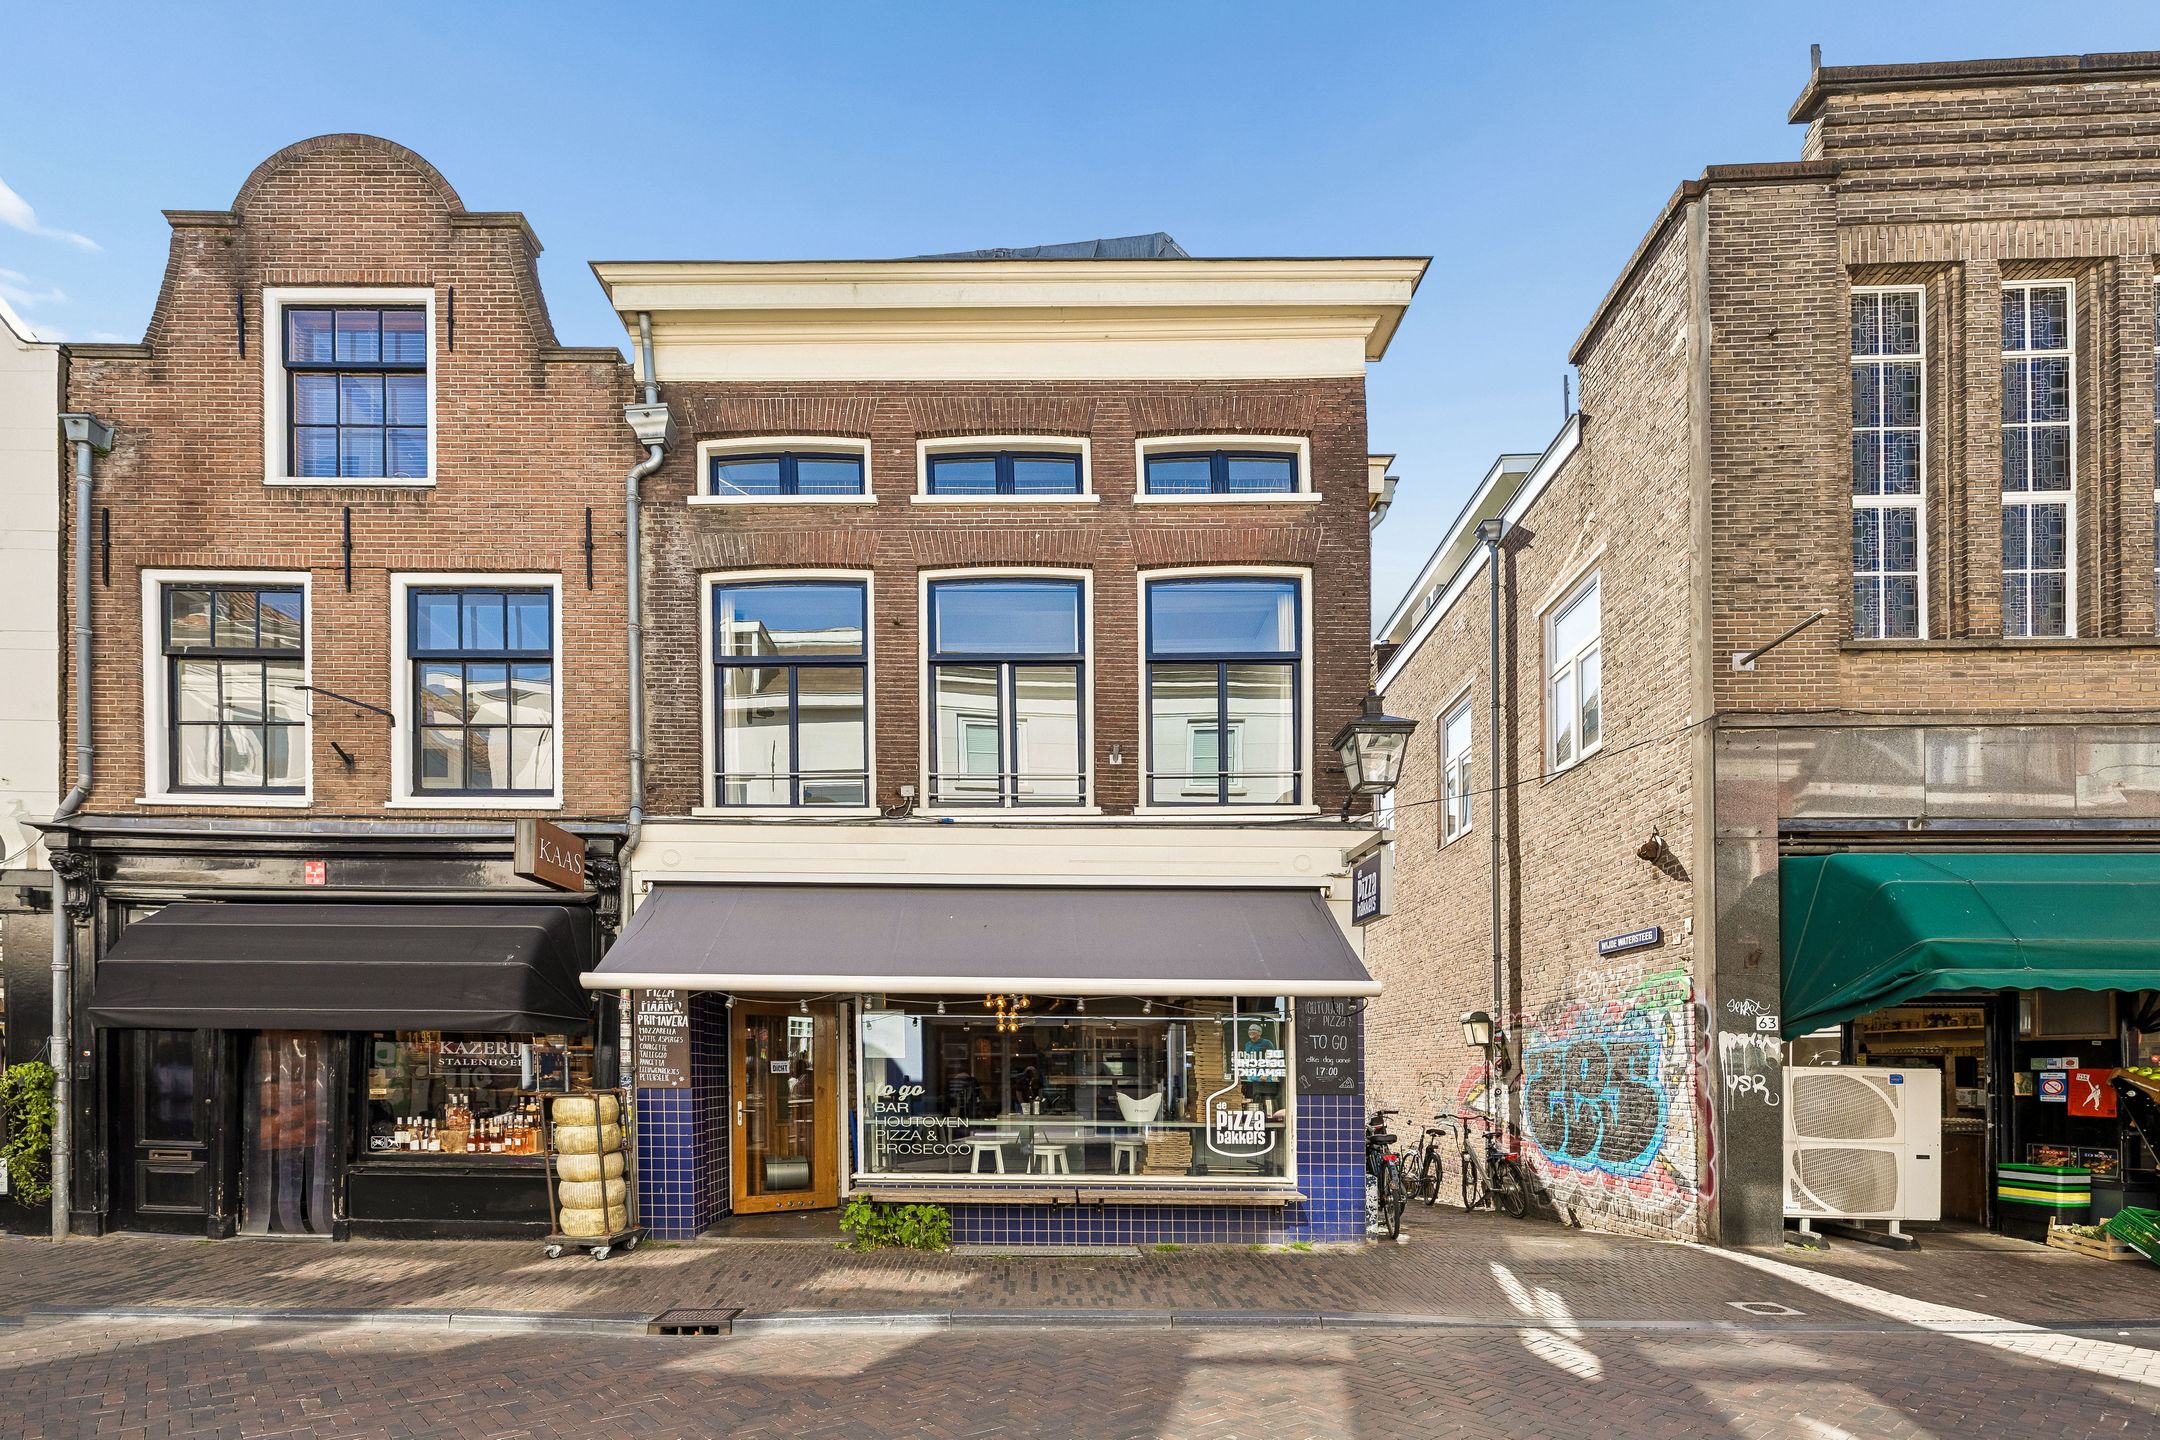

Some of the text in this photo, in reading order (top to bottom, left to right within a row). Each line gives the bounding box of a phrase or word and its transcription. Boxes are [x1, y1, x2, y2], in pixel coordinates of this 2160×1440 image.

[539, 837, 582, 875] KAAS
[1601, 931, 1653, 950] WIJDE WATERSTEEG
[637, 1014, 689, 1028] PRIMAVERA
[1758, 1017, 1777, 1029] 63
[638, 1027, 677, 1035] MOZZARELLA
[638, 1035, 684, 1044] WITTE ASPERGES
[1309, 1034, 1348, 1051] TO GO
[439, 1041, 524, 1059] KAZERIJ
[639, 1043, 667, 1052] COURGETTE
[1322, 1056, 1334, 1066] dag
[1316, 1066, 1338, 1076] 17:00
[874, 1083, 926, 1101] to go
[874, 1102, 909, 1113] BAR
[1215, 1101, 1228, 1110] de
[875, 1116, 969, 1128] HOUTOVEN
[875, 1130, 938, 1142] PIZZA &
[1216, 1130, 1266, 1145] bakkers
[875, 1143, 972, 1155] PROSECCO
